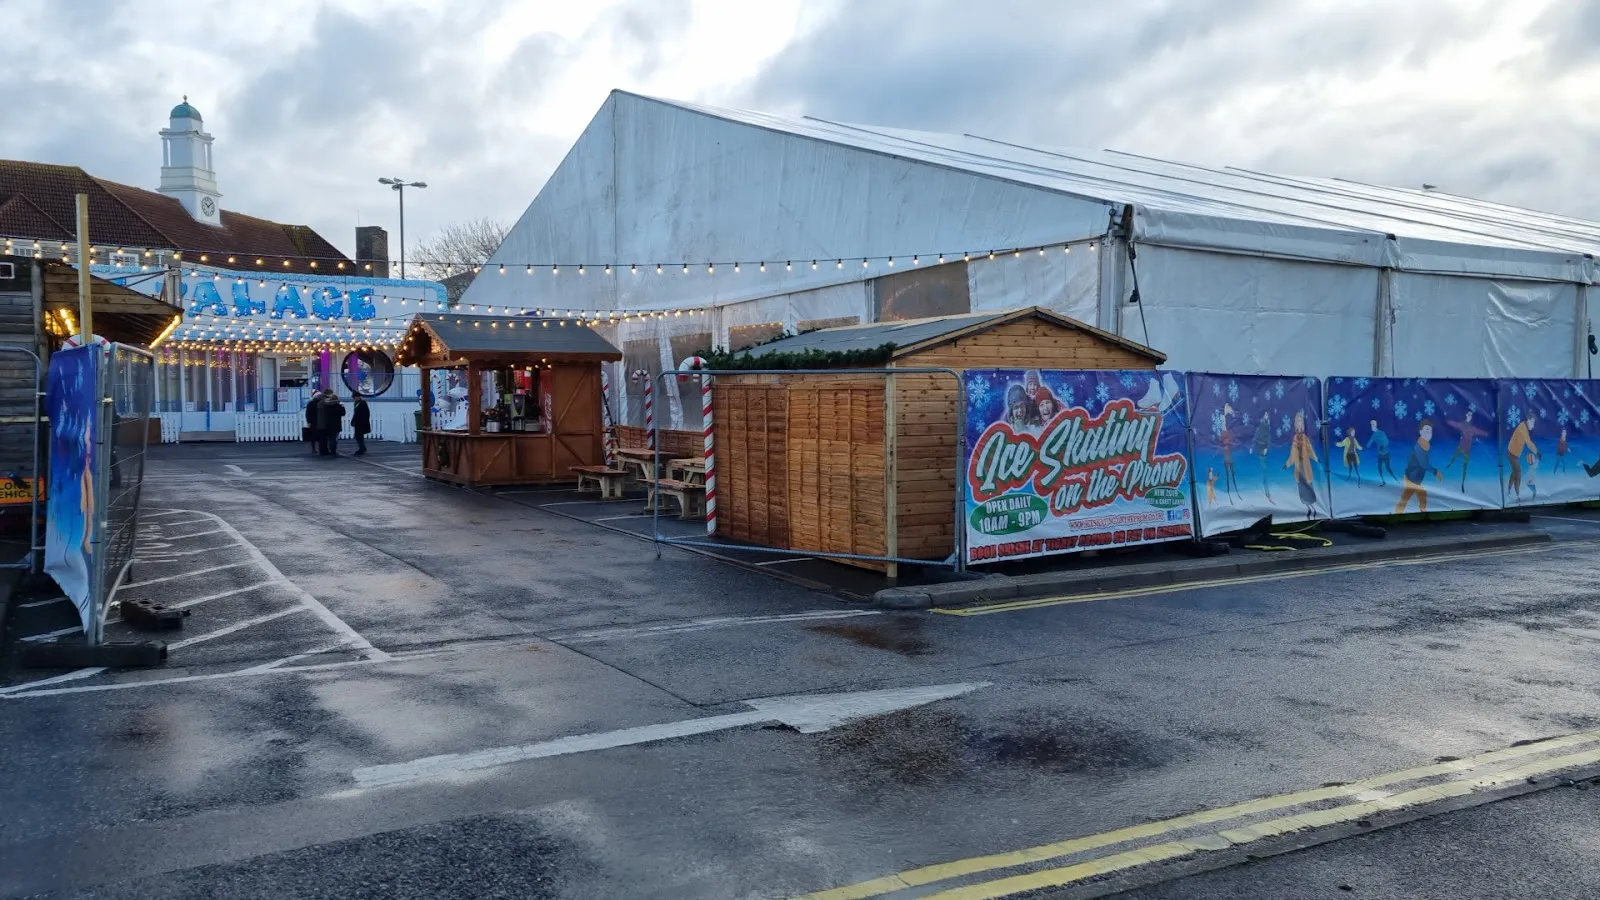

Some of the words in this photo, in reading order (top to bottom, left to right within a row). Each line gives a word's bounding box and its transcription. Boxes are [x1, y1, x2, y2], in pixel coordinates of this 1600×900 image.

[976, 431, 1034, 492] Ice
[1040, 408, 1157, 486] Skating
[1054, 481, 1083, 510] on
[1085, 469, 1119, 502] the
[1122, 459, 1180, 495] Prom
[979, 514, 1008, 533] 10AM
[1018, 510, 1041, 527] 9PM
[986, 498, 1007, 514] OPEN
[1009, 495, 1032, 510] DAILY
